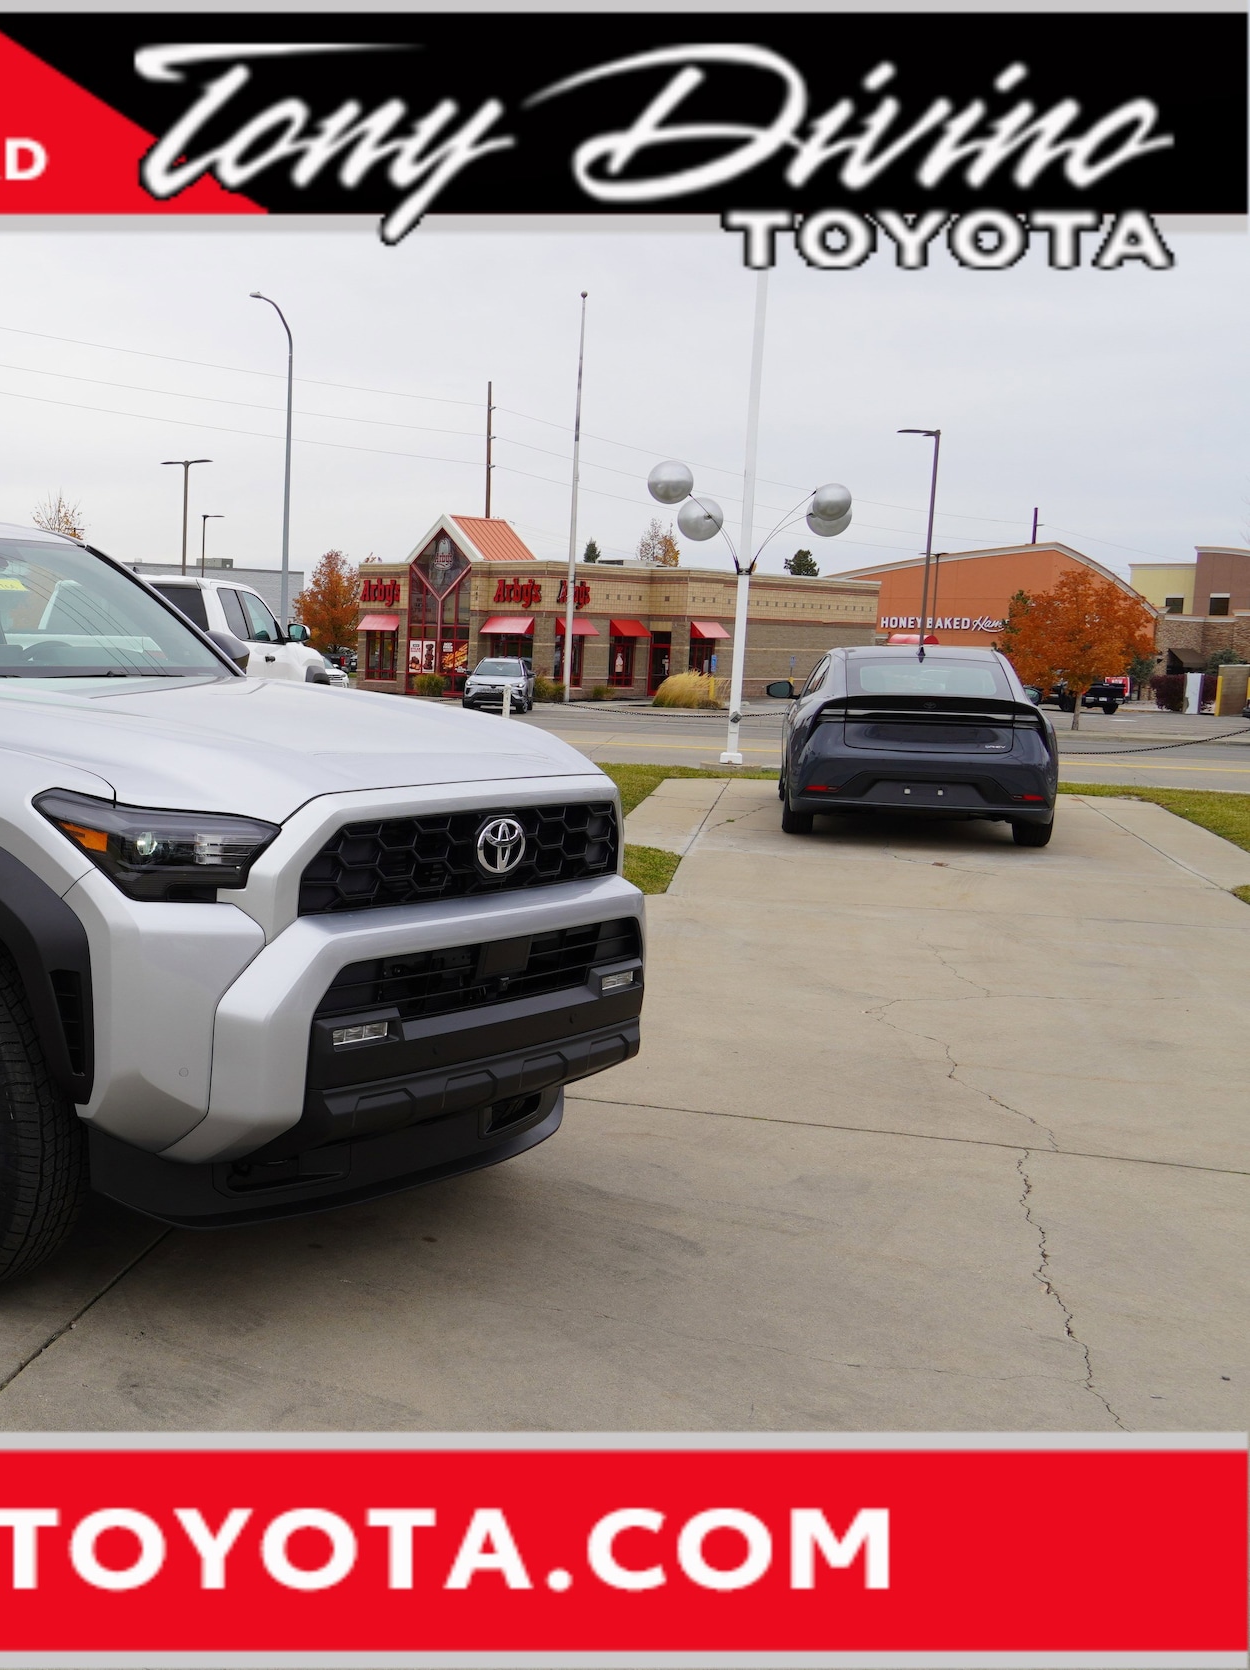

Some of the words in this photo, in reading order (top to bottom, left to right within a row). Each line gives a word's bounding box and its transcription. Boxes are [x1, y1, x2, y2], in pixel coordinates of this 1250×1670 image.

[359, 577, 401, 607] Arby's
[493, 577, 542, 609] Arby's
[556, 579, 591, 610] Ay's
